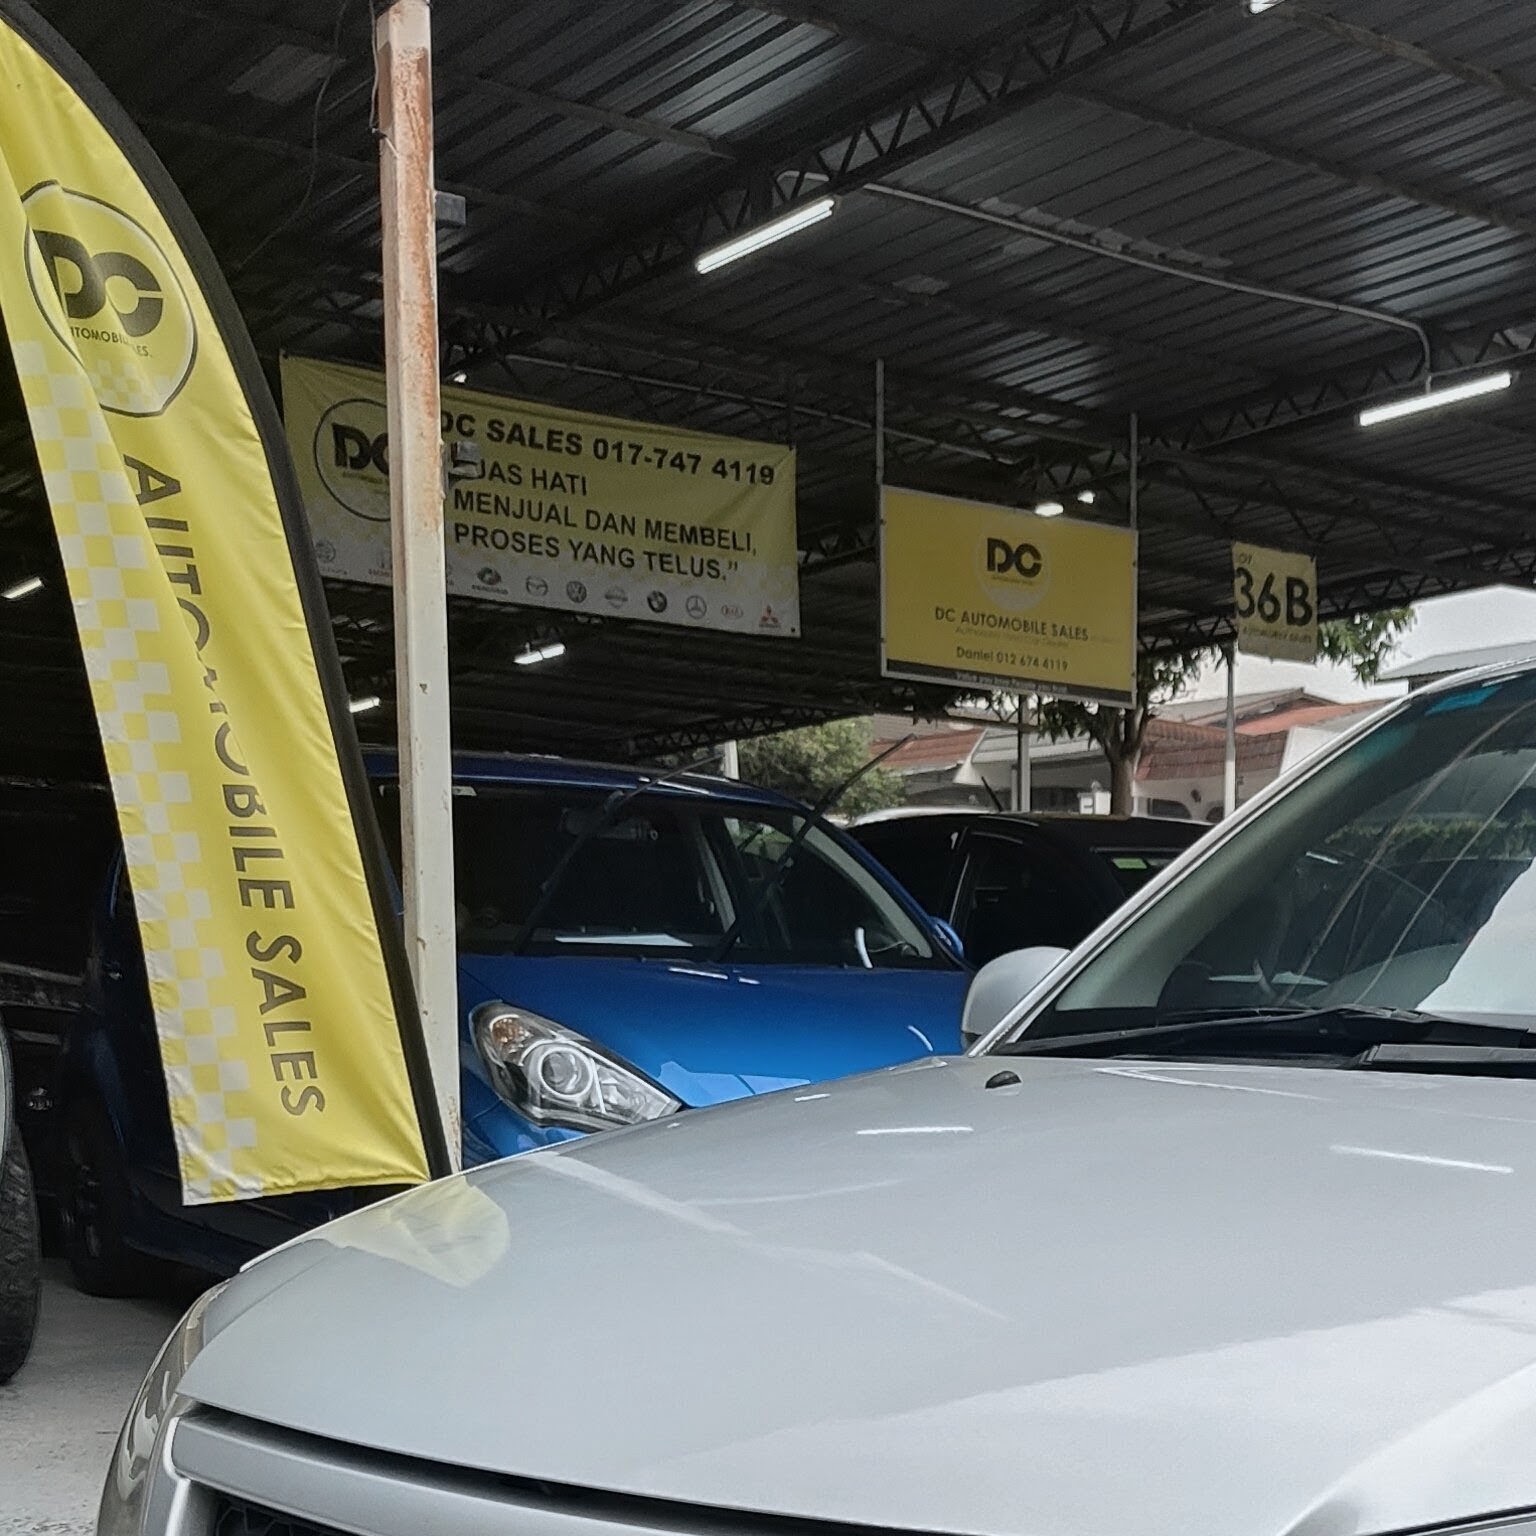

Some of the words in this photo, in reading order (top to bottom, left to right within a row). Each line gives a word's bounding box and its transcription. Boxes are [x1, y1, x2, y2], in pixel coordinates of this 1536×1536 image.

[33, 229, 164, 338] DC
[486, 418, 583, 456] SALES
[593, 437, 701, 475] 017-747
[712, 458, 775, 486] 4119
[531, 467, 587, 496] HATI
[454, 488, 577, 528] MENJUAL
[586, 509, 636, 536] DAN
[645, 518, 757, 556] MEMBELI,
[454, 522, 560, 558] PROSES
[568, 538, 636, 568] YANG
[986, 537, 1042, 578] DC
[1236, 566, 1313, 627] 36B
[935, 606, 956, 622] DC
[961, 610, 1047, 636] AUTOMOBILE
[1052, 623, 1089, 641] SALES
[956, 646, 994, 662] Daniel
[996, 651, 1016, 666] 012
[1020, 655, 1039, 669] 674
[246, 930, 326, 1116] SALES
